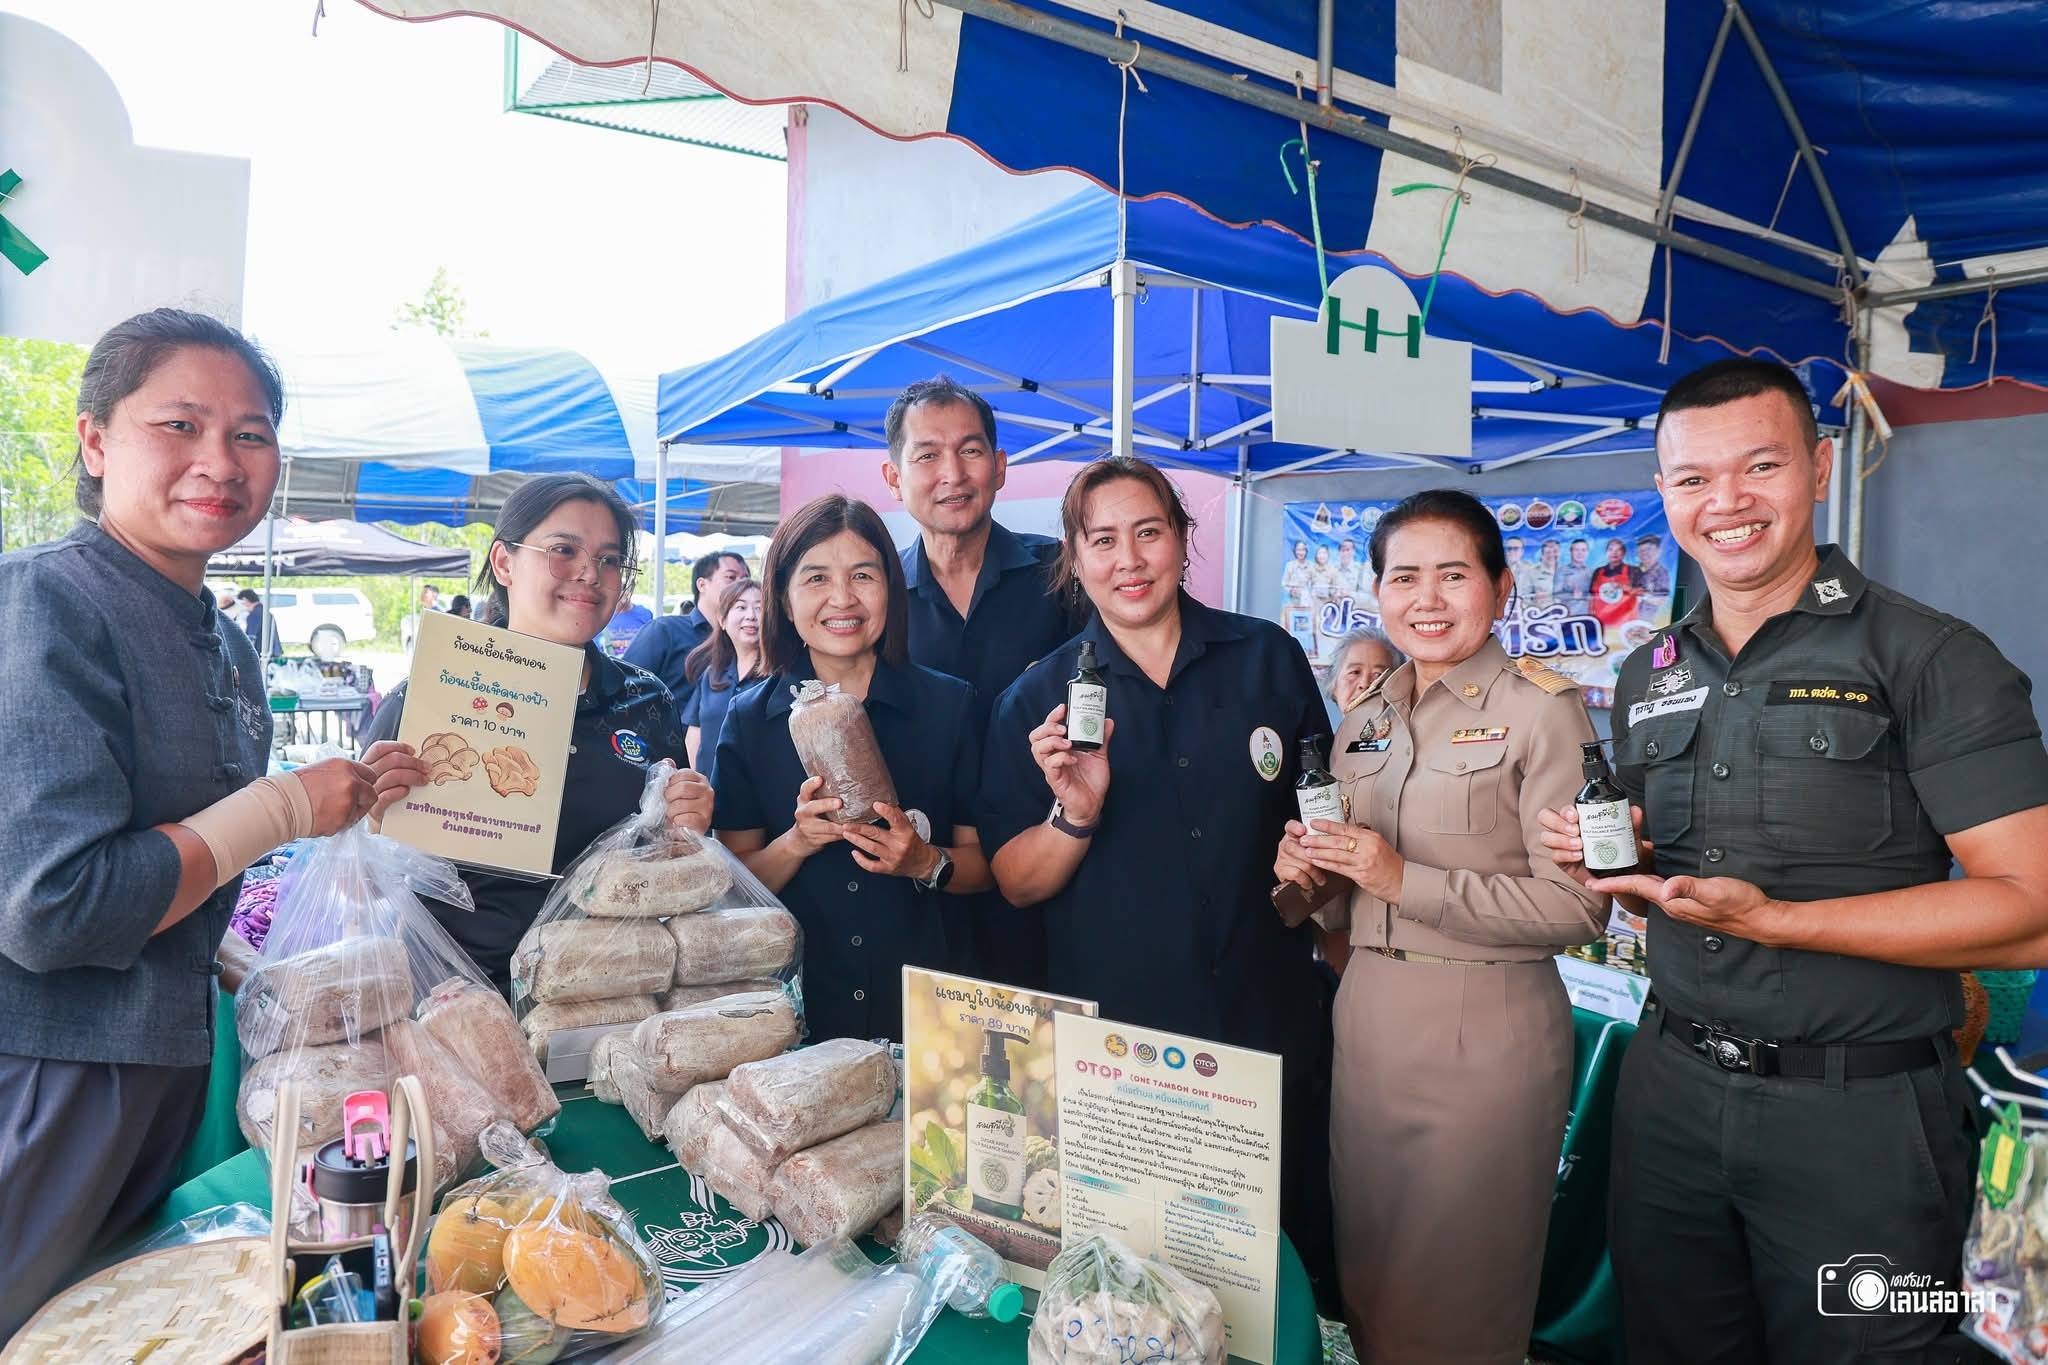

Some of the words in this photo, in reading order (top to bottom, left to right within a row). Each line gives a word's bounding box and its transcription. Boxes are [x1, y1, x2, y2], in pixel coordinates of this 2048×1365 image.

[454, 635, 547, 671] ก้อนเชื้อเห็ดขอน
[440, 668, 548, 708] ก้อนเชื้อเห็ดนางฟ้า
[450, 713, 481, 729] ราคา
[484, 719, 497, 732] 10
[499, 725, 526, 740] บาท
[959, 1013, 985, 1027] ราคา
[988, 1018, 1003, 1030] 89
[1005, 1022, 1031, 1037] บาท
[1076, 1060, 1122, 1080] OTOP
[1130, 1074, 1151, 1085] (ONE
[1153, 1079, 1189, 1094] TAMBON
[1192, 1088, 1209, 1098] ONE
[1212, 1092, 1258, 1109] PRODUCT)
